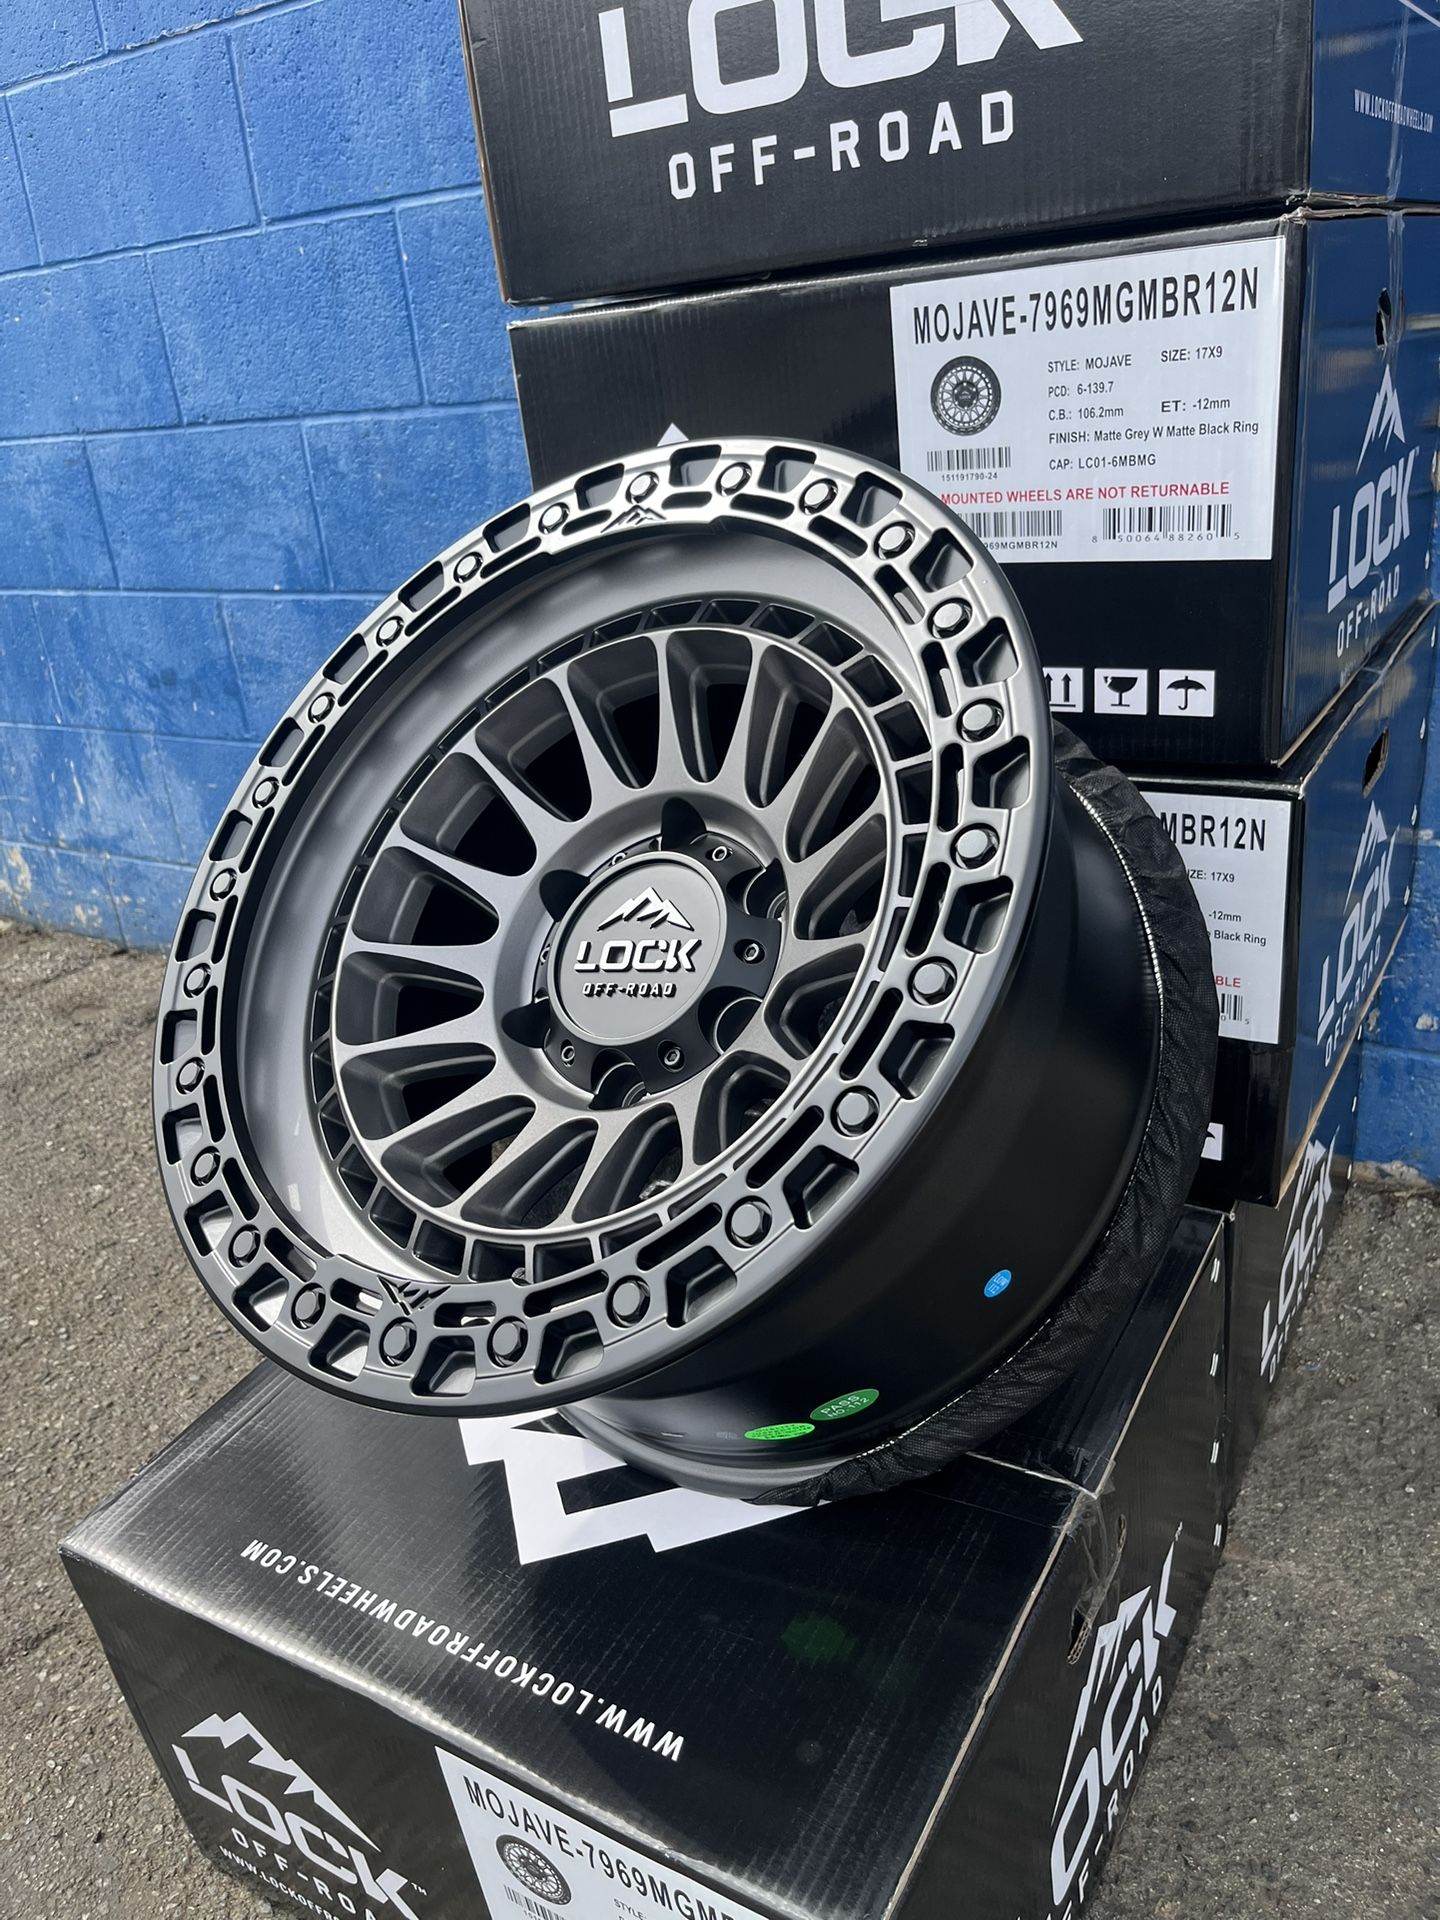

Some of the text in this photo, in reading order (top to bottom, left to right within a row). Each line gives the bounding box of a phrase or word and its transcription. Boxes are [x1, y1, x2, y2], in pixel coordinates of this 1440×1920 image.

[668, 90, 1014, 199] OFF-ROAD
[913, 266, 1259, 344] MOJAVE-7969MGMBR12N
[1048, 354, 1132, 373] STYLE: MOJAVE
[1160, 346, 1223, 362] SIZE: 17X9
[1048, 381, 1114, 398] PCD: 6-139.7
[1048, 407, 1124, 421] C.B.: 106.2mm
[1161, 398, 1230, 412] ET: -12mm
[1049, 420, 1259, 444] FINISH: Matte Grey W Matte Black Ring
[1049, 454, 1156, 470] CAP: LC01-6MBMG
[941, 482, 1230, 505] MOUNTED WHEELS ARE NOT RETURNABLE
[1328, 447, 1416, 614] LOCK
[1337, 564, 1400, 658] OFF-ROAD
[1210, 872, 1235, 882] 17X9
[1208, 910, 1242, 922] -12mm
[1214, 930, 1241, 942] Black
[1244, 933, 1266, 947] Ring
[1317, 826, 1400, 1045] LOCK
[574, 938, 702, 973] LOCK
[582, 982, 677, 998] OFF-ROAD
[1260, 1134, 1335, 1377] LOCK
[240, 1540, 684, 1762] WWW.LOCKOFFROADWHEELS.COM
[1020, 1542, 1177, 1919] OCK
[171, 1744, 419, 1919] LOCK
[463, 1775, 735, 1919] MOJAVE-7969MGM
[231, 1828, 376, 1919] OFF-ROA
